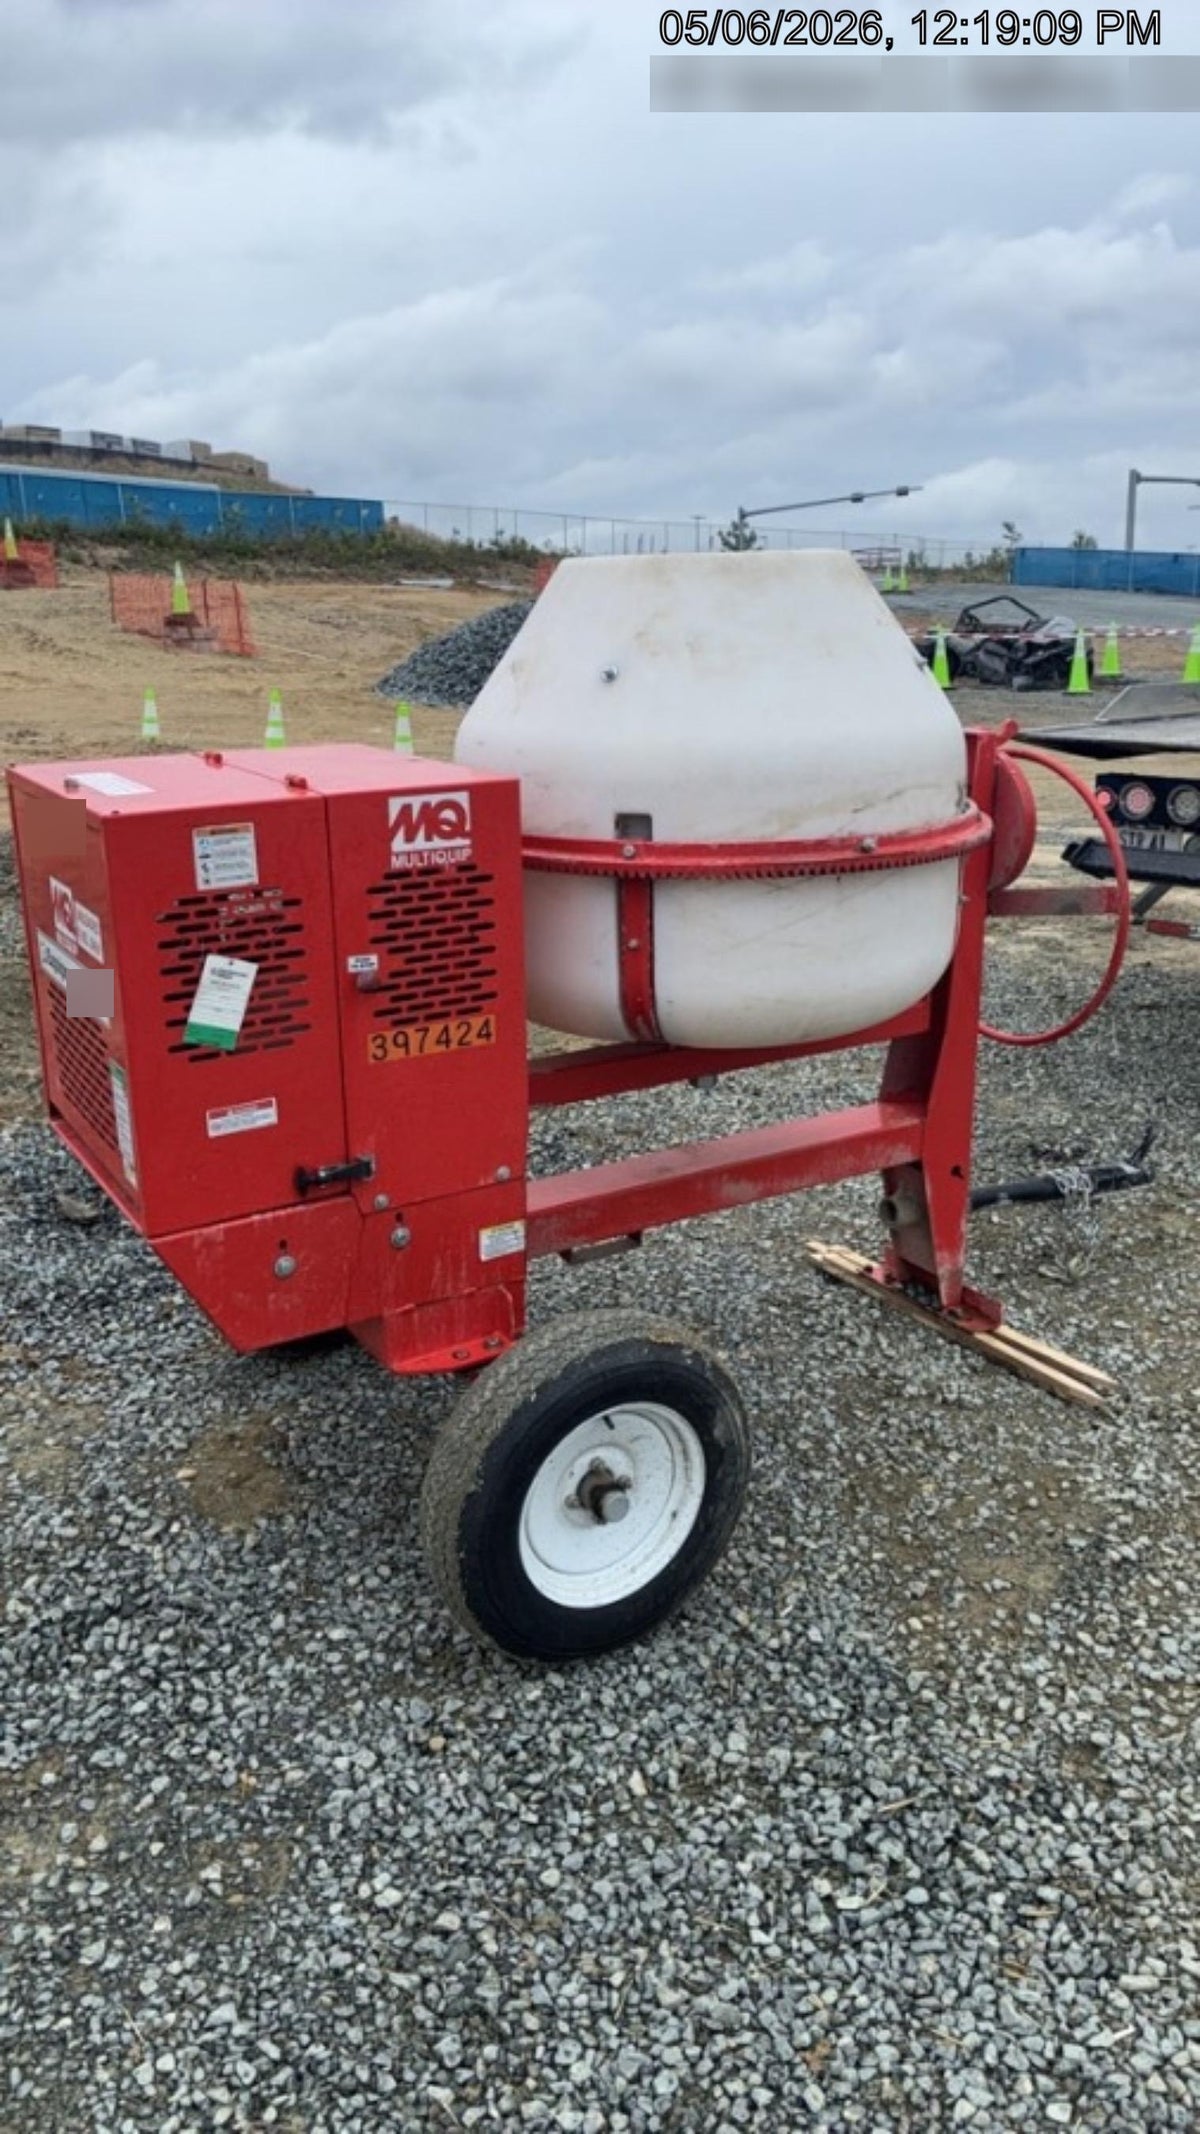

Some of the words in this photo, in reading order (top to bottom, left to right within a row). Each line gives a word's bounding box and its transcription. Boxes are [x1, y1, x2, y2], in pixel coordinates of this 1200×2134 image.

[389, 799, 470, 844] MQ
[390, 848, 472, 869] MULTIQUIP
[371, 1017, 493, 1061] 397424
